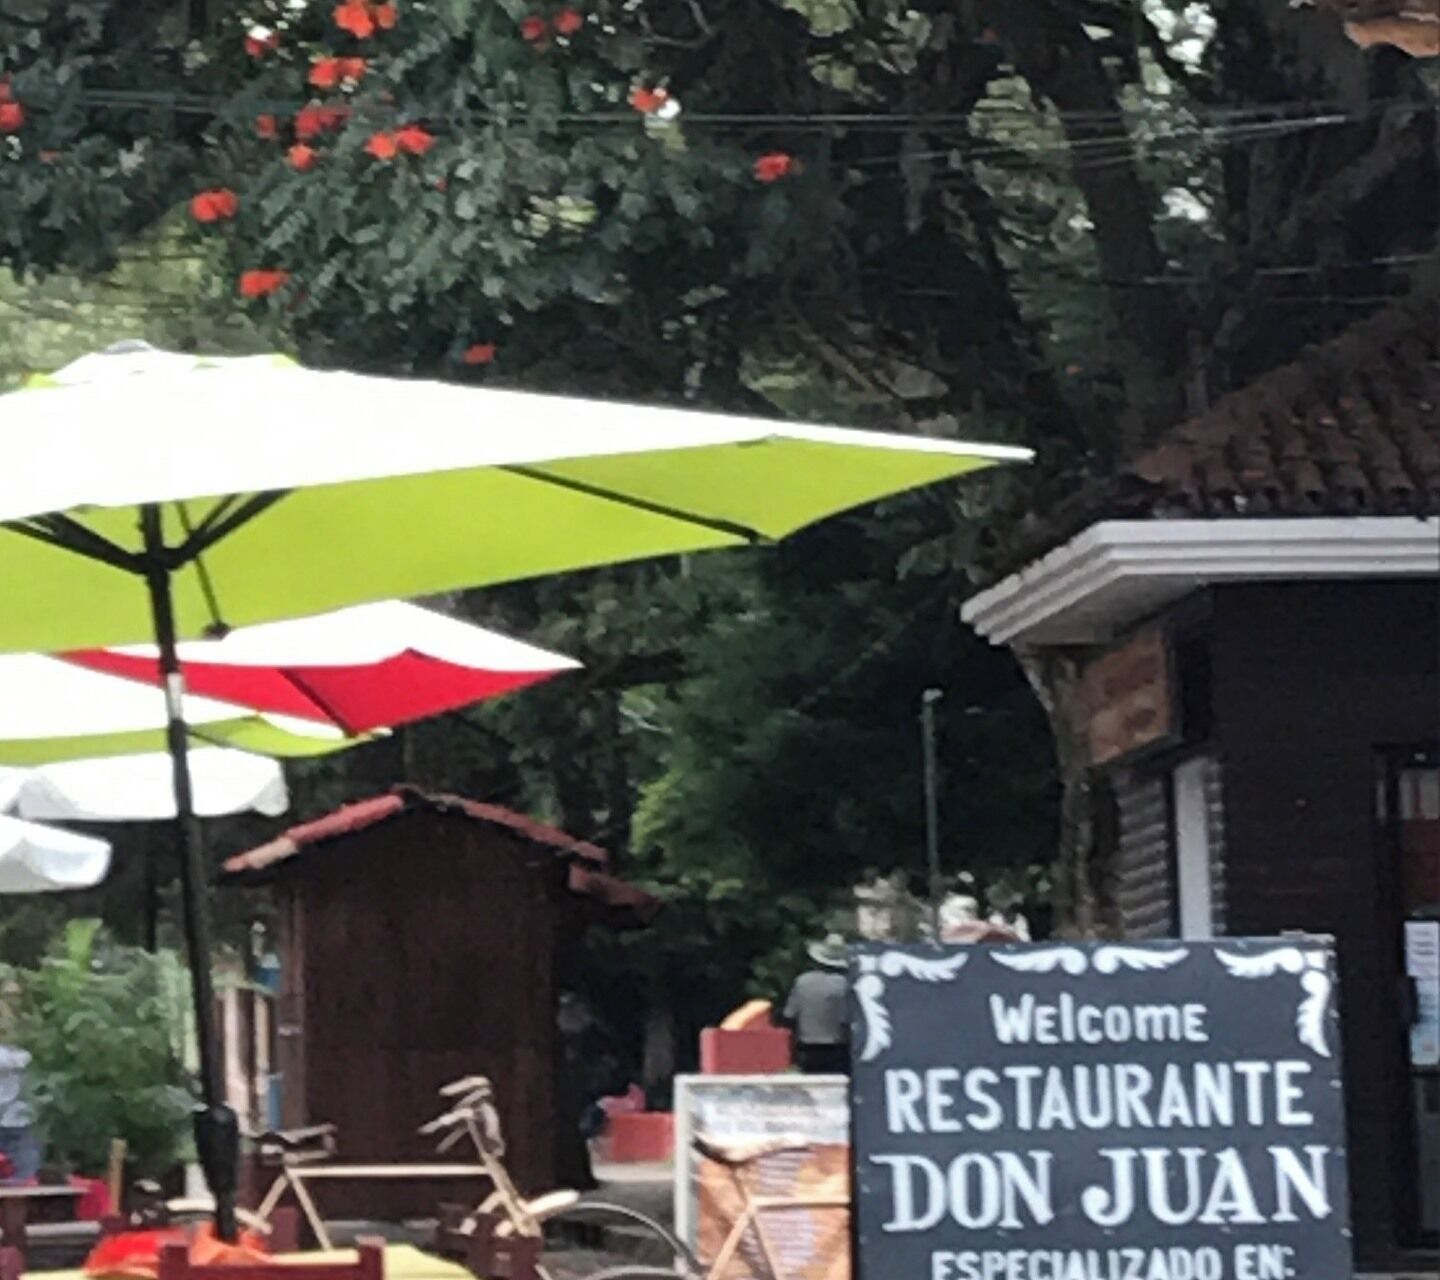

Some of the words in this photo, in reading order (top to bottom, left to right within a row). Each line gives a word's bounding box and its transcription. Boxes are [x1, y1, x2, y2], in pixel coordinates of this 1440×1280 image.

[884, 1059, 1314, 1134] RESTAURANTE
[869, 1149, 1055, 1232] DON
[1080, 1144, 1333, 1227] JUAN
